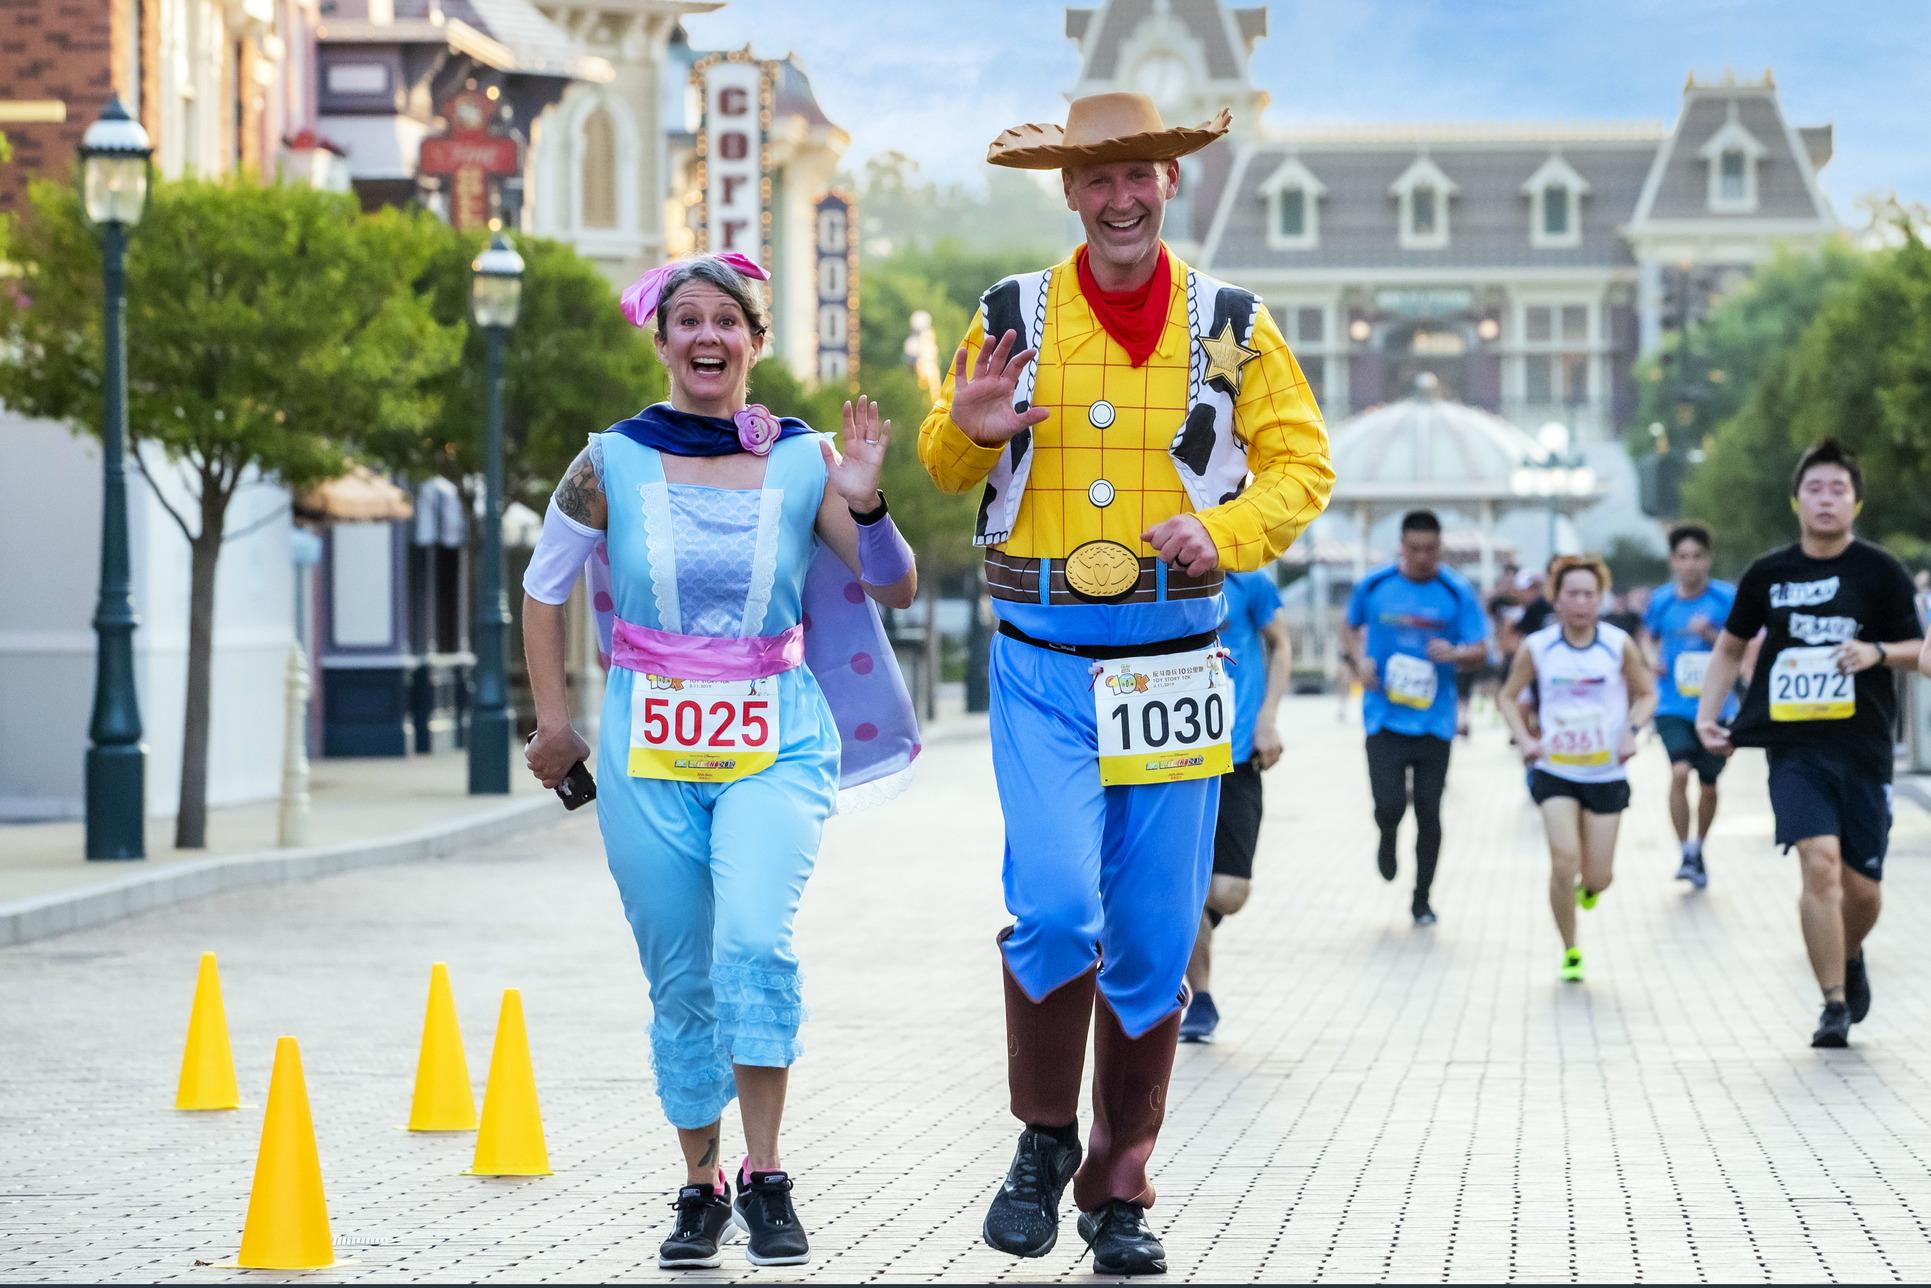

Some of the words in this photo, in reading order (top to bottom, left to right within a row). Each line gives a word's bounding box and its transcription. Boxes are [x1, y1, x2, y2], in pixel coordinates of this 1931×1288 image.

[1777, 672, 1848, 700] 2072
[643, 697, 769, 747] 5025
[1112, 692, 1224, 751] 1030
